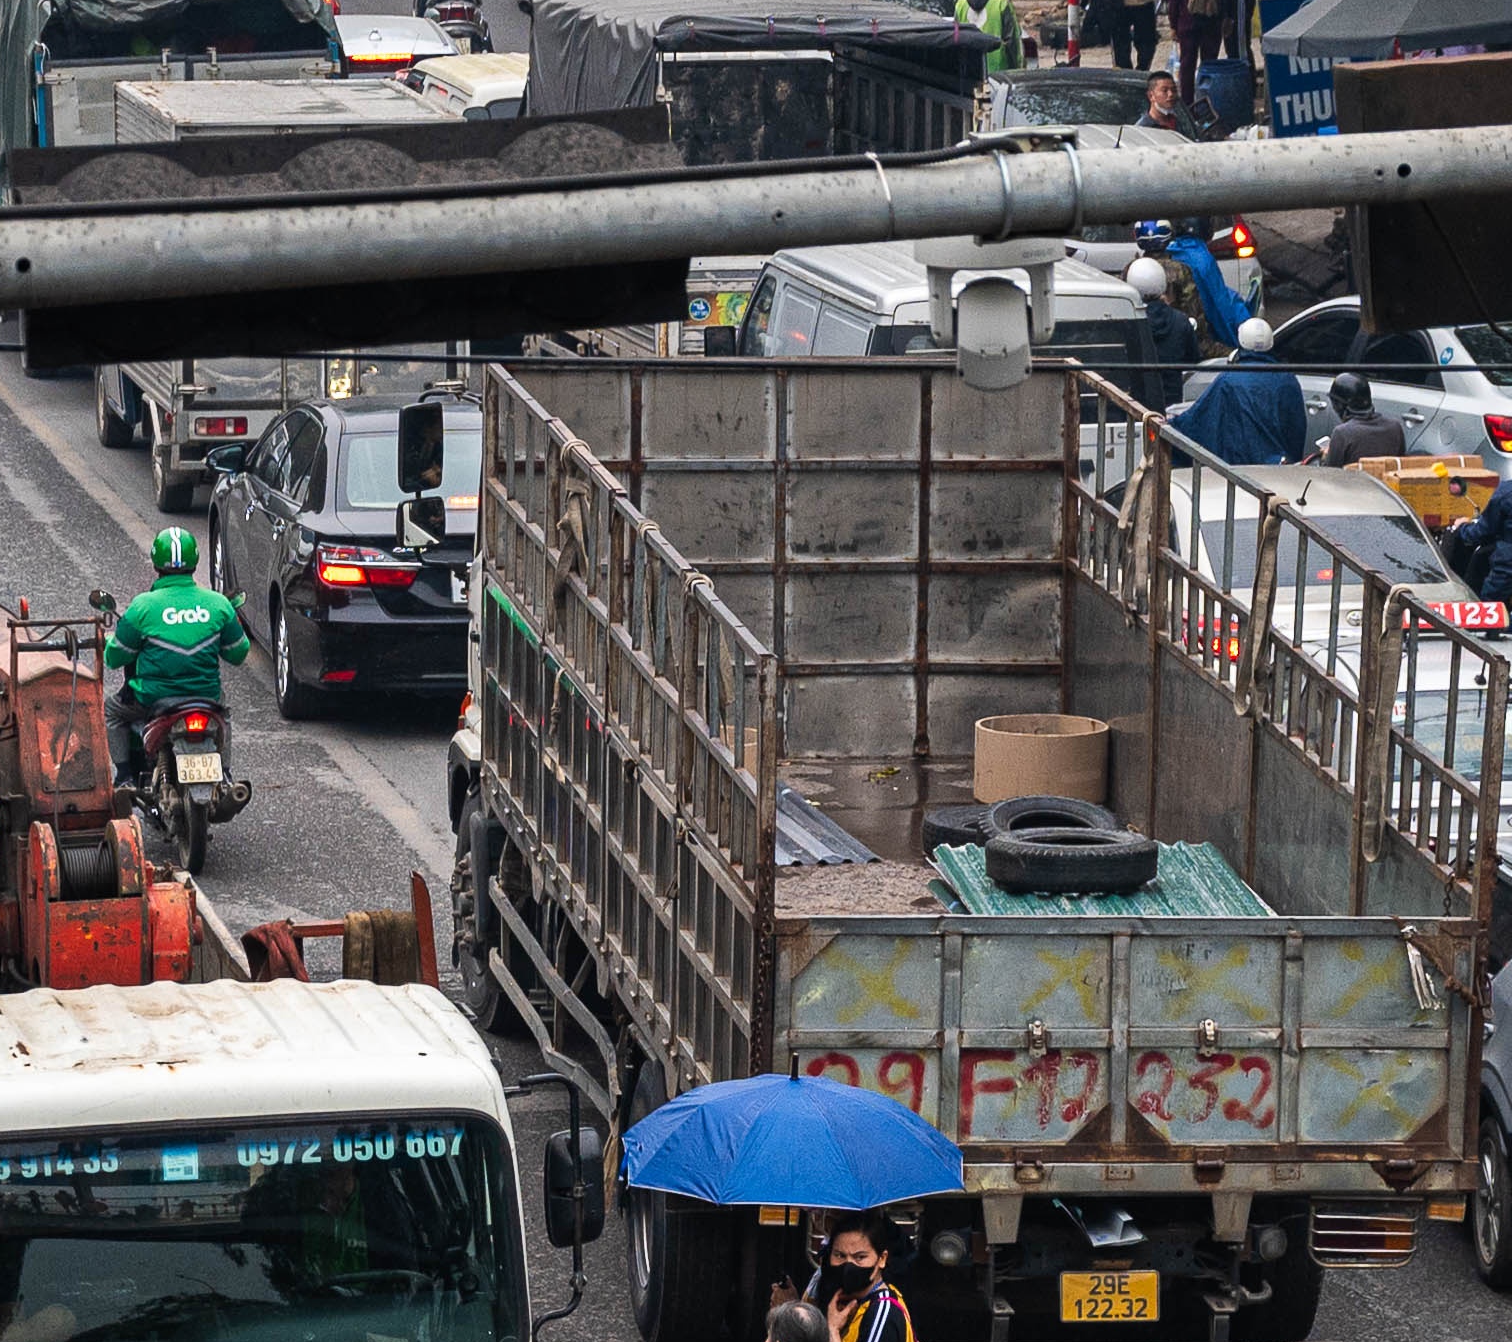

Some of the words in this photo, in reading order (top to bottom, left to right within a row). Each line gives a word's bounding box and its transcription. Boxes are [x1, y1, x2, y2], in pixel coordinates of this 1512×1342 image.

[1275, 87, 1336, 127] THU
[162, 604, 211, 625] Grab
[1136, 1050, 1276, 1131] 232
[236, 1138, 323, 1169] 0972
[333, 1133, 396, 1164] 050
[405, 1129, 467, 1160] 667
[1088, 1275, 1130, 1297] 29E
[1074, 1297, 1149, 1320] 122.32
